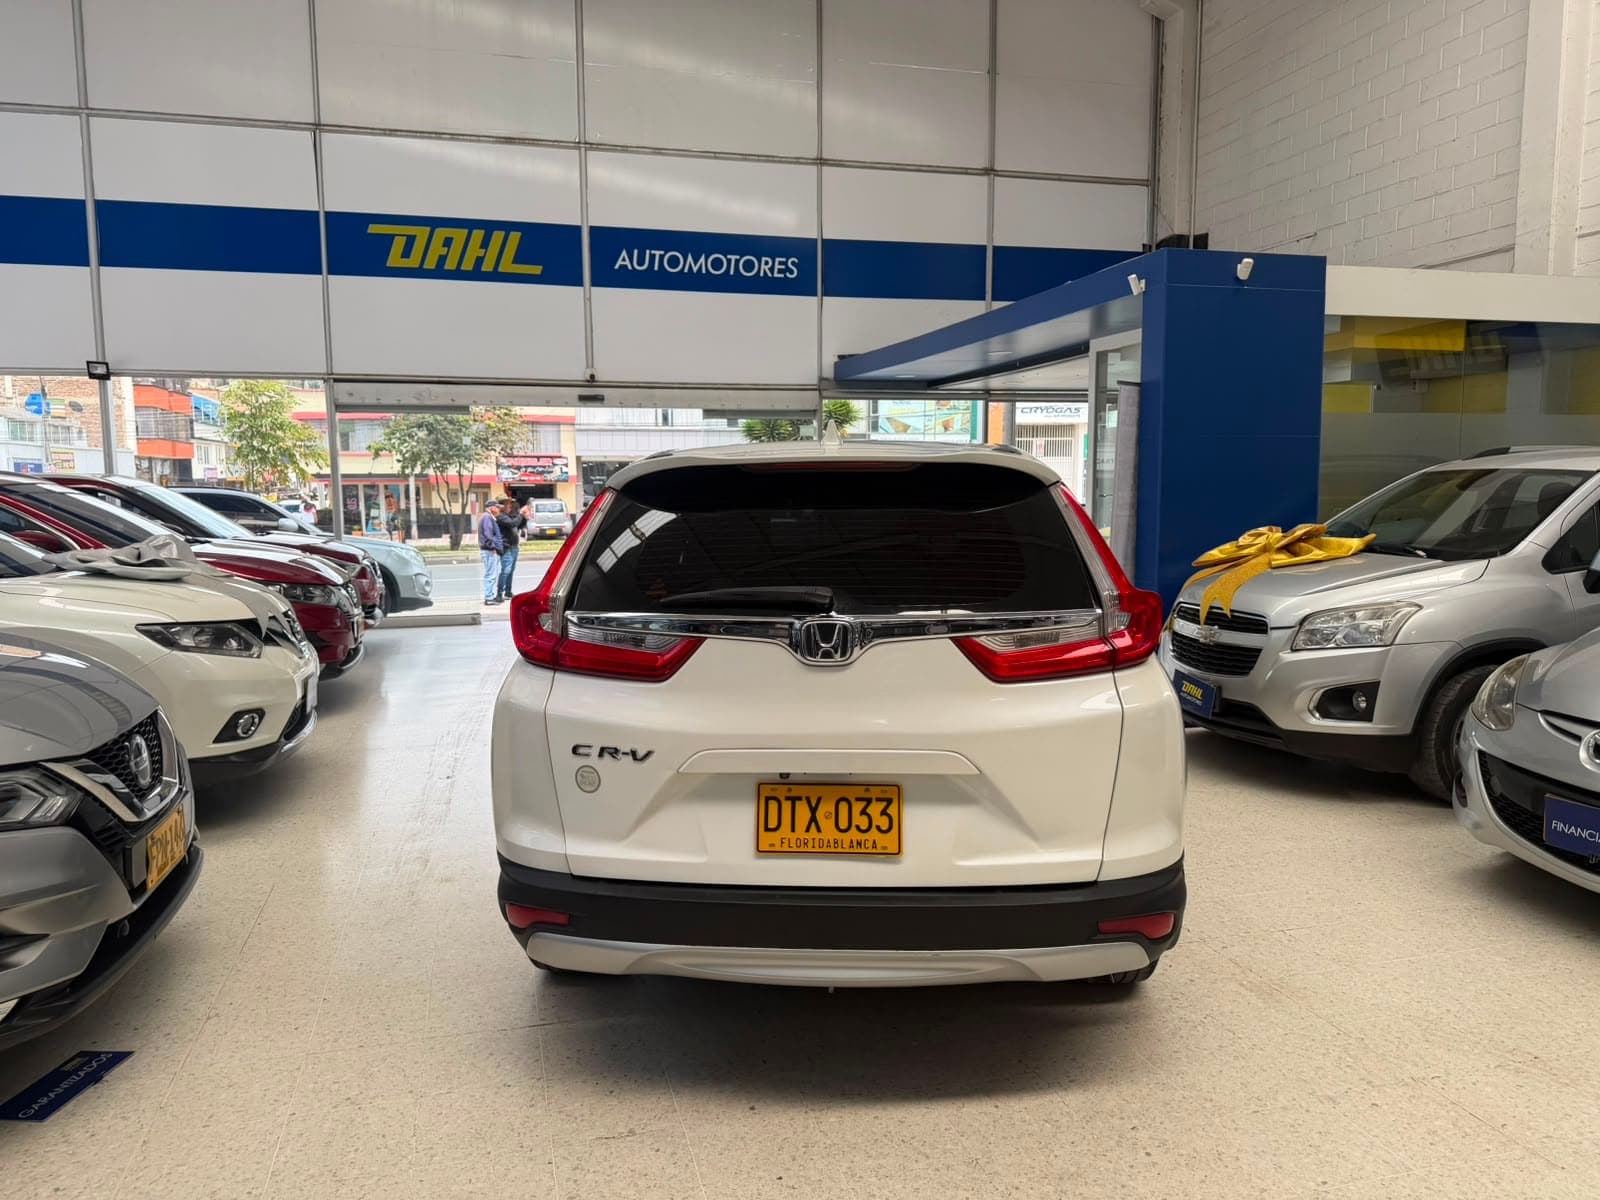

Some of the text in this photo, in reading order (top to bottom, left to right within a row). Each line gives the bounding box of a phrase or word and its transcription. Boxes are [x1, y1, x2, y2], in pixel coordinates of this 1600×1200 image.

[367, 224, 799, 278] DAHL AUTOMOTORES
[1020, 406, 1081, 414] CRYOGAS
[1181, 681, 1204, 700] DAHL
[571, 744, 655, 762] CR-V
[764, 796, 894, 834] DTX 033
[1551, 820, 1600, 843] FINANCI
[780, 837, 878, 850] FLORIDABLANCA
